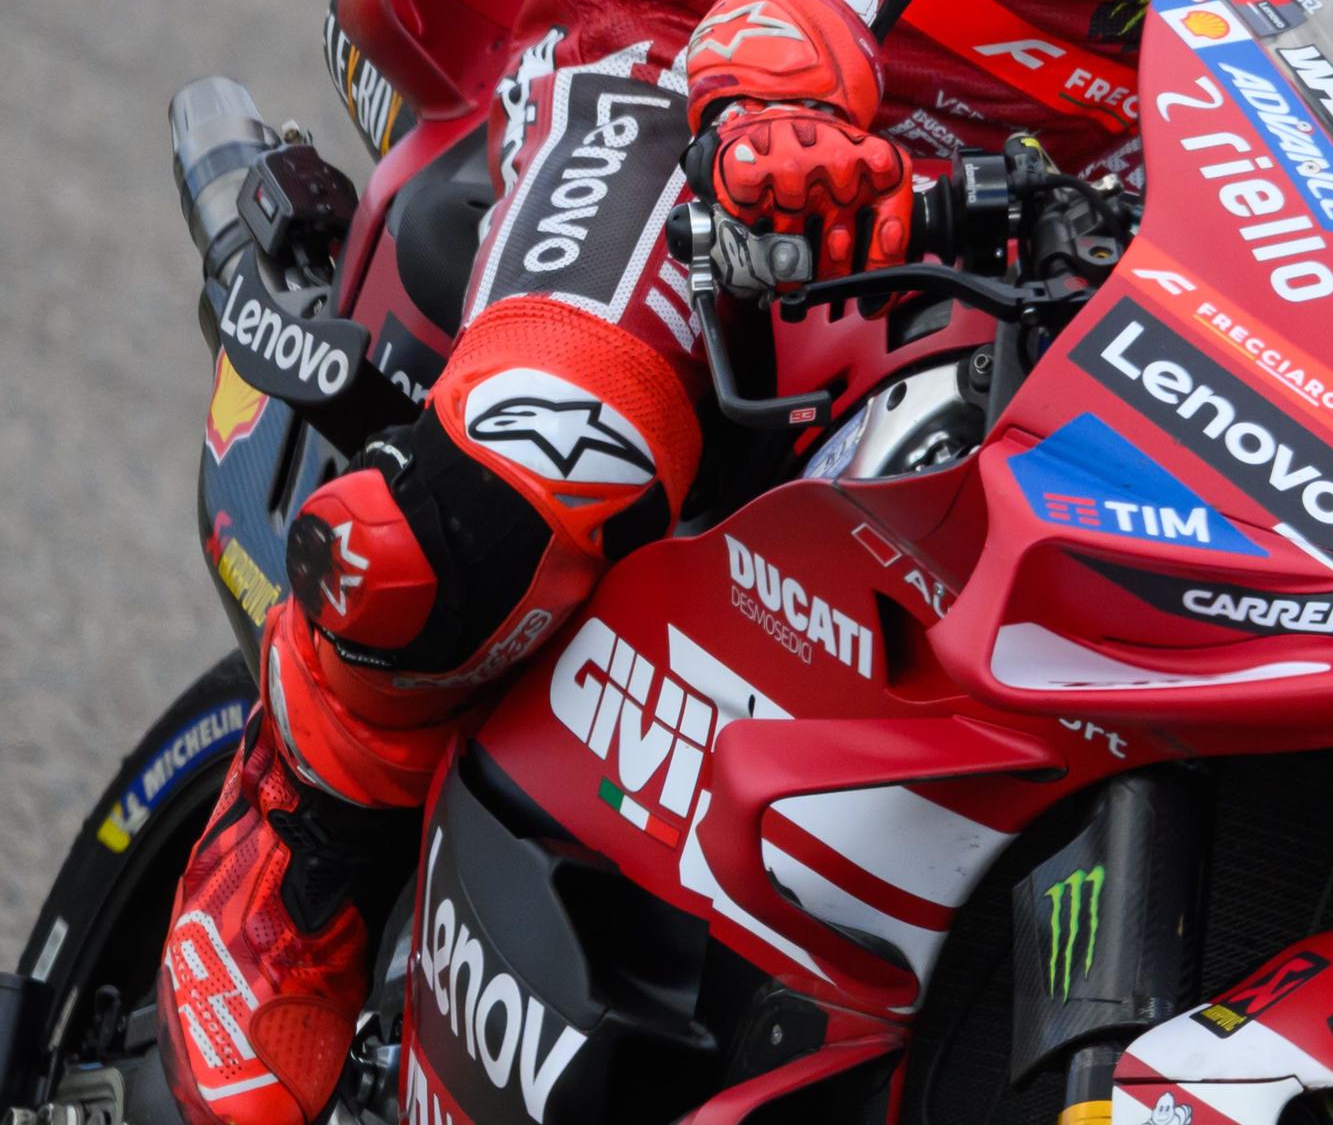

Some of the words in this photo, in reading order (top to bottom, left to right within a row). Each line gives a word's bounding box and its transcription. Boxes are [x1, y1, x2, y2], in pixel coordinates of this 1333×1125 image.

[323, 10, 404, 156] LEX-BOX
[523, 92, 671, 273] Lenovo
[220, 275, 349, 395] Lenovo
[1104, 500, 1211, 543] TIM
[724, 533, 874, 680] DUCATI
[731, 585, 813, 666] DESMOSEDICI
[141, 699, 244, 799] MICHELIN
[550, 616, 713, 819] GIVI
